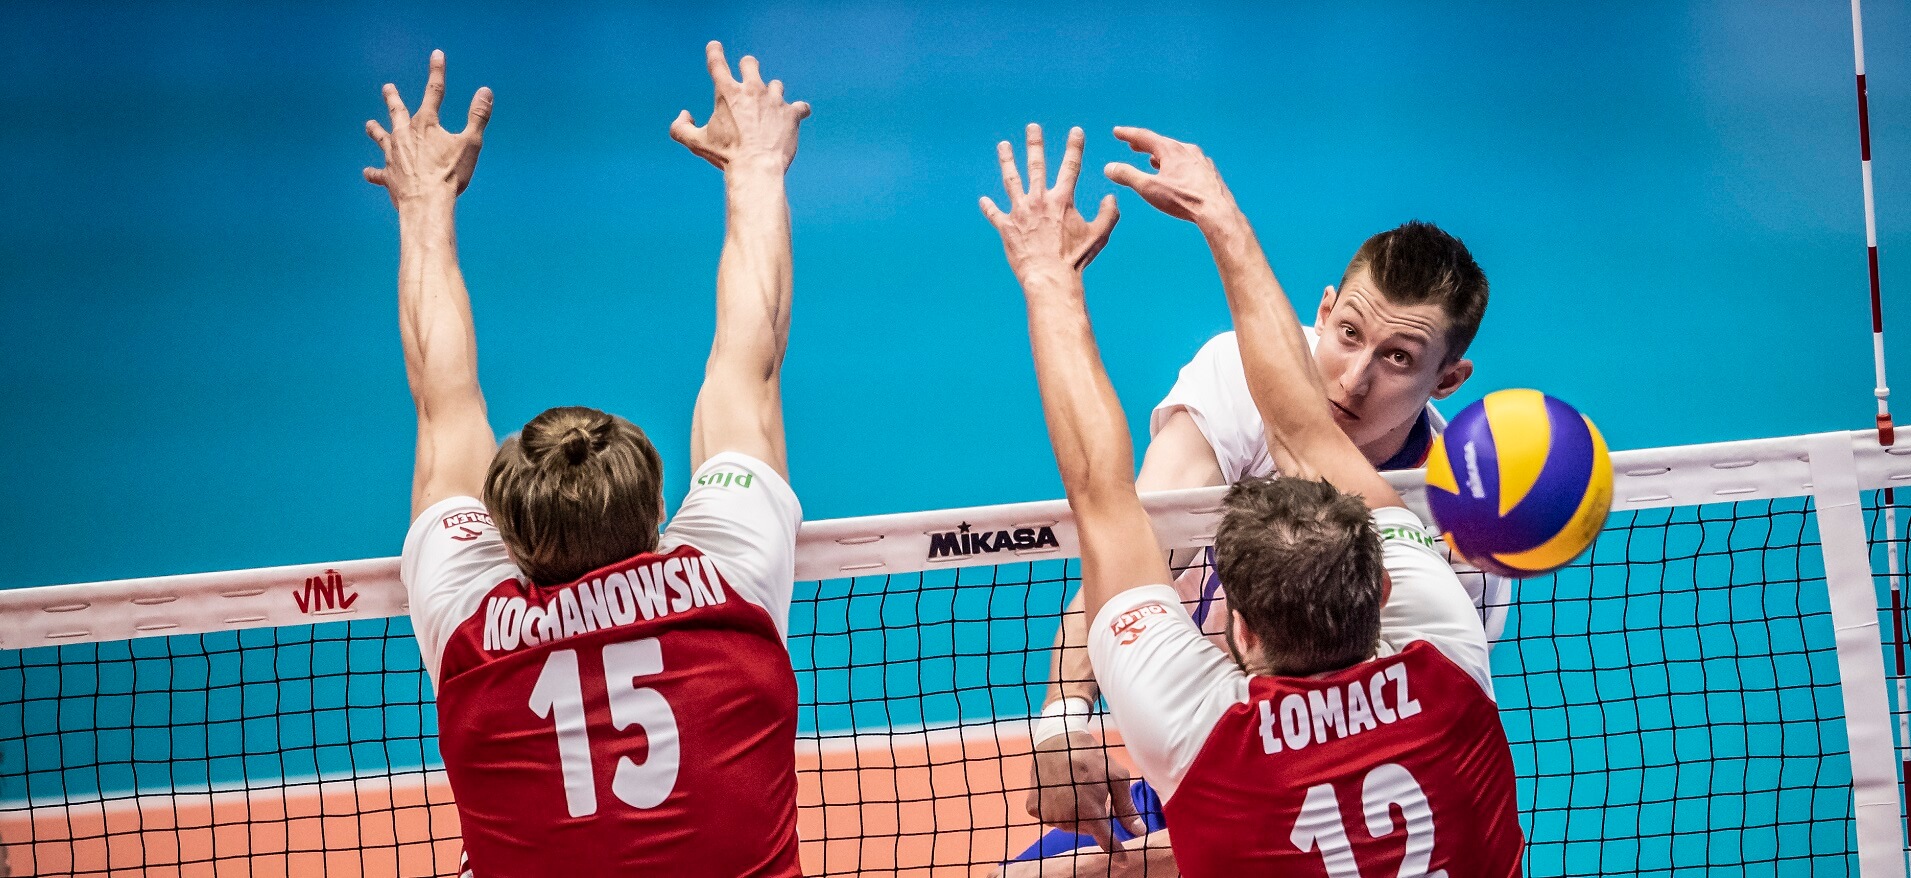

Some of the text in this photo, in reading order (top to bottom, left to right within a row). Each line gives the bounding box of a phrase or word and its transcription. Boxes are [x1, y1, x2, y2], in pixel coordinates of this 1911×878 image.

[698, 472, 753, 489] plus
[445, 511, 496, 528] ORLEN
[928, 521, 1060, 558] MIKASA
[292, 573, 359, 614] VNL
[483, 555, 727, 651] KOCHANOWSKI
[528, 637, 681, 818] 15
[1258, 662, 1422, 755] ŁOMACZ
[1290, 763, 1449, 878] 12
